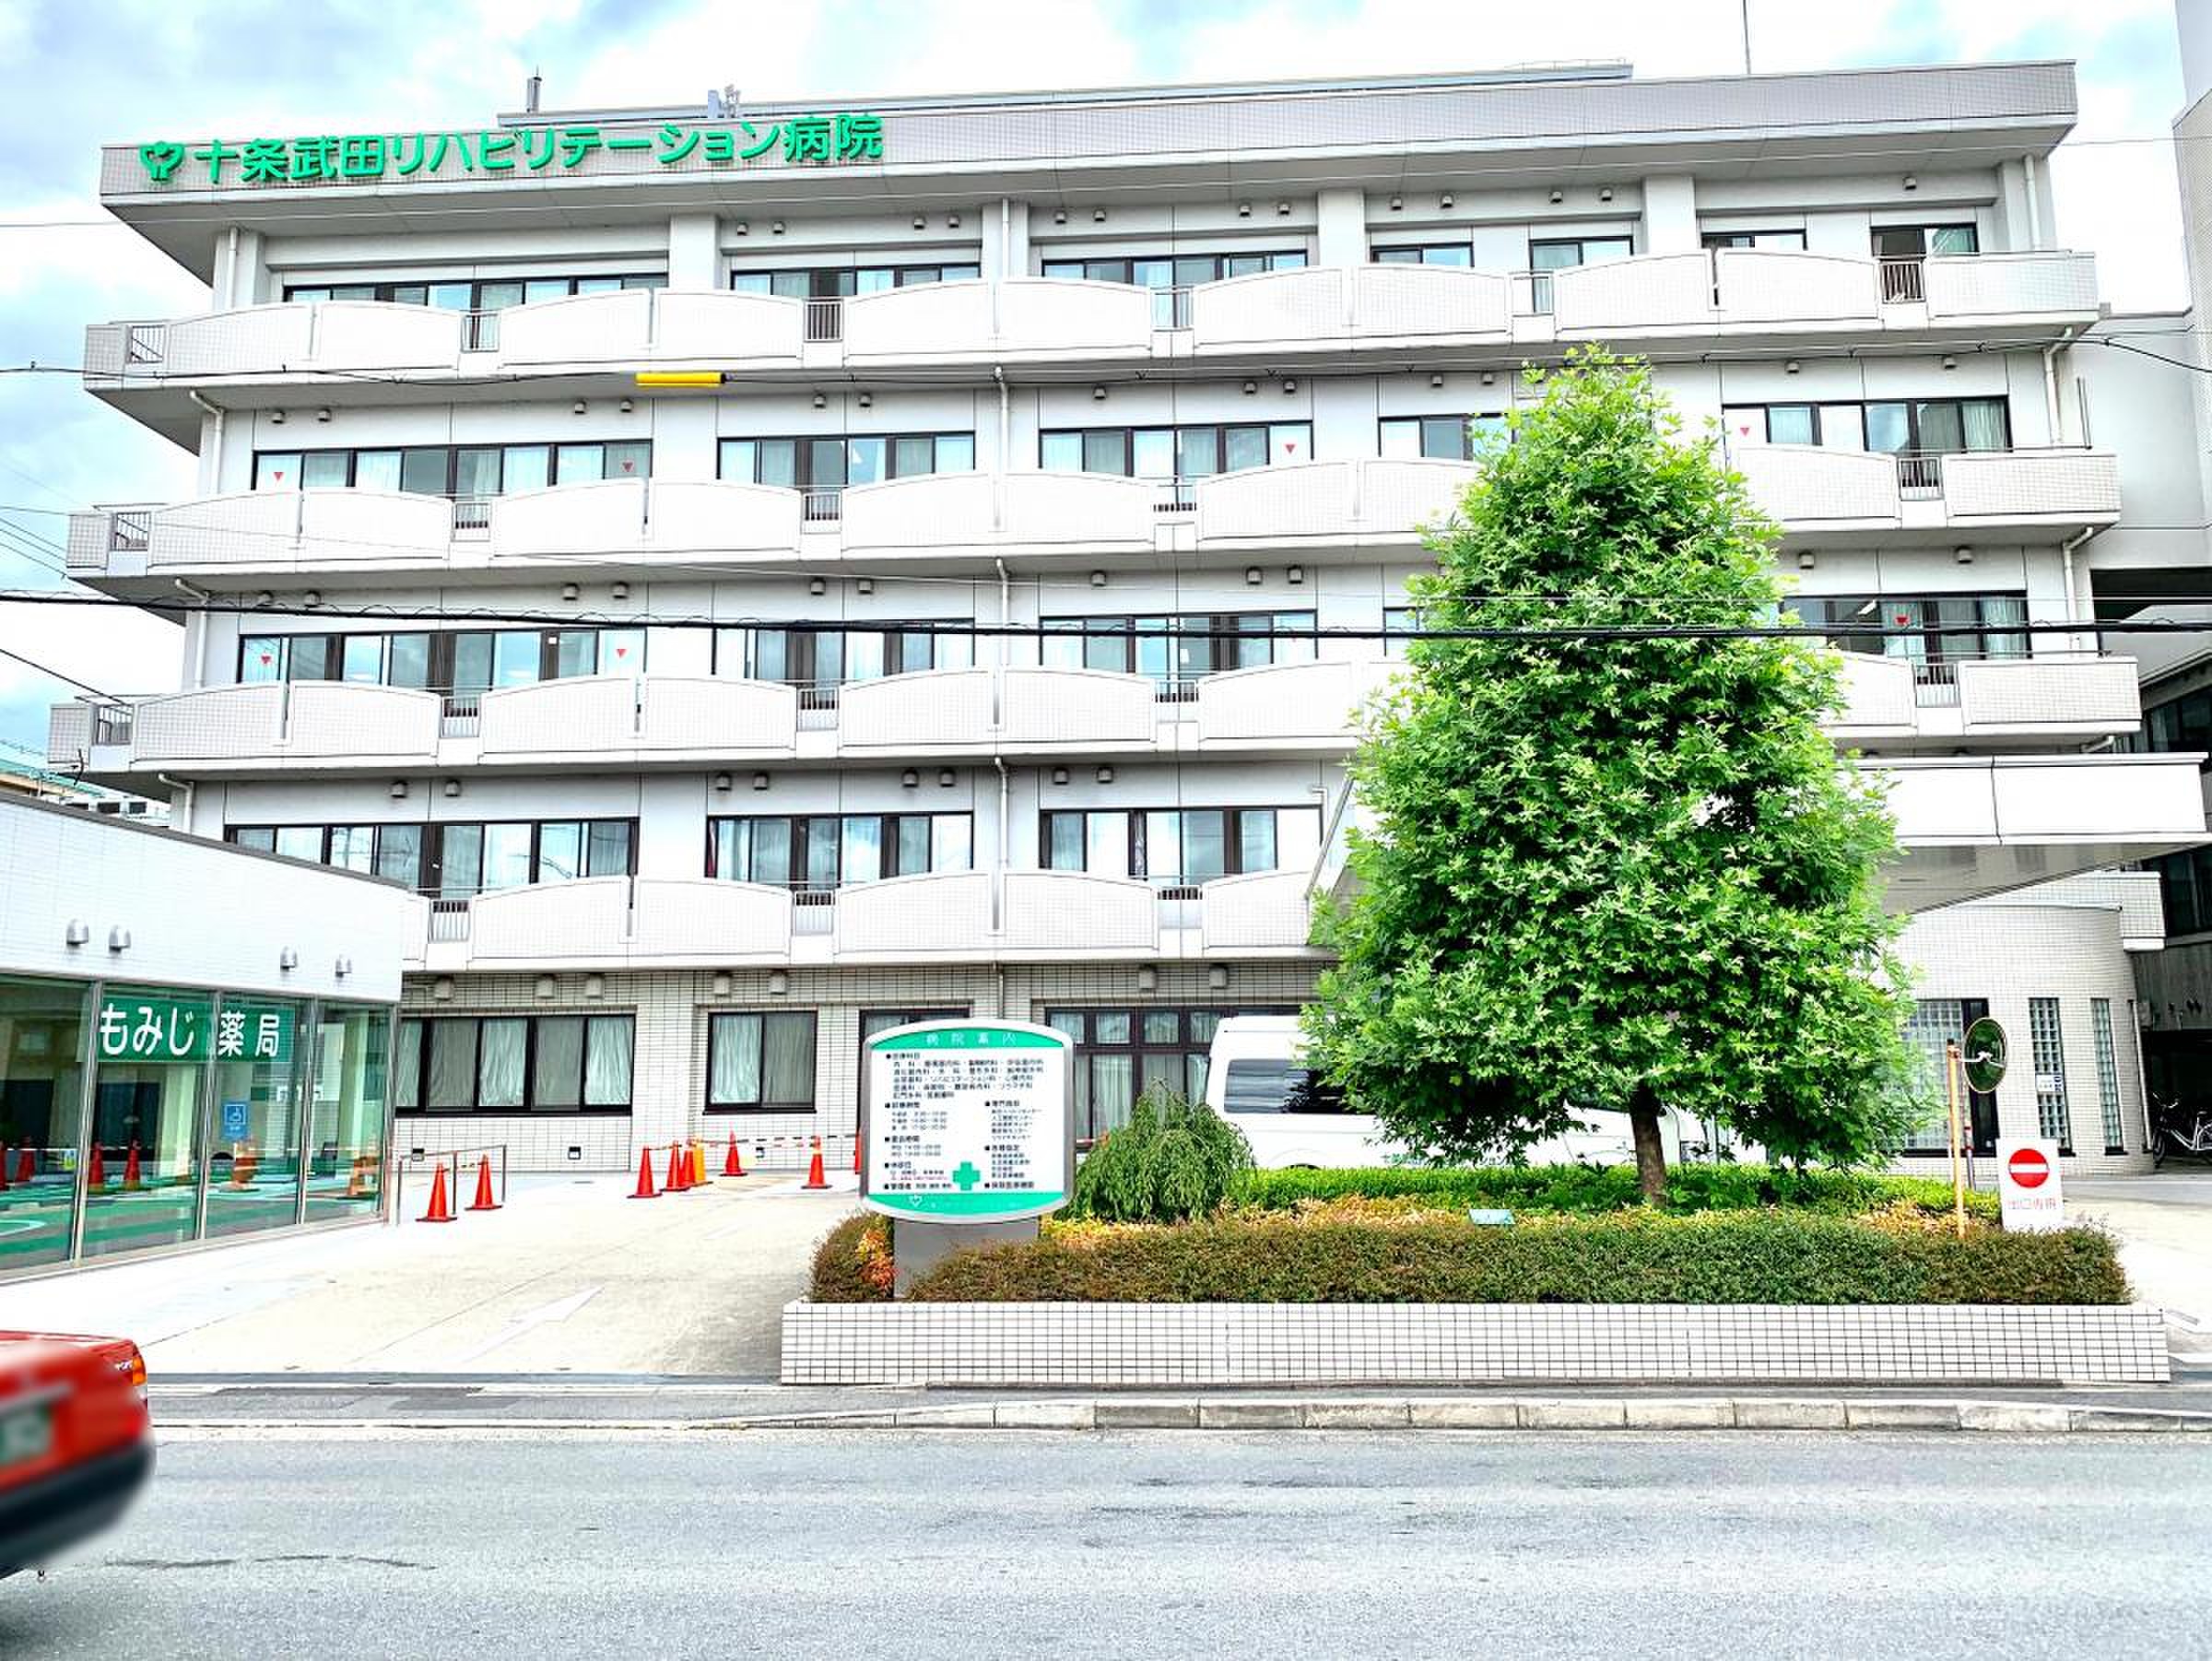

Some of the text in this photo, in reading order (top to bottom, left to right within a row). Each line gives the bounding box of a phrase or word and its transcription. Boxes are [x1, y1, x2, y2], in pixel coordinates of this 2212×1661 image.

[194, 113, 885, 184] 十条武田リハビリテーション病院
